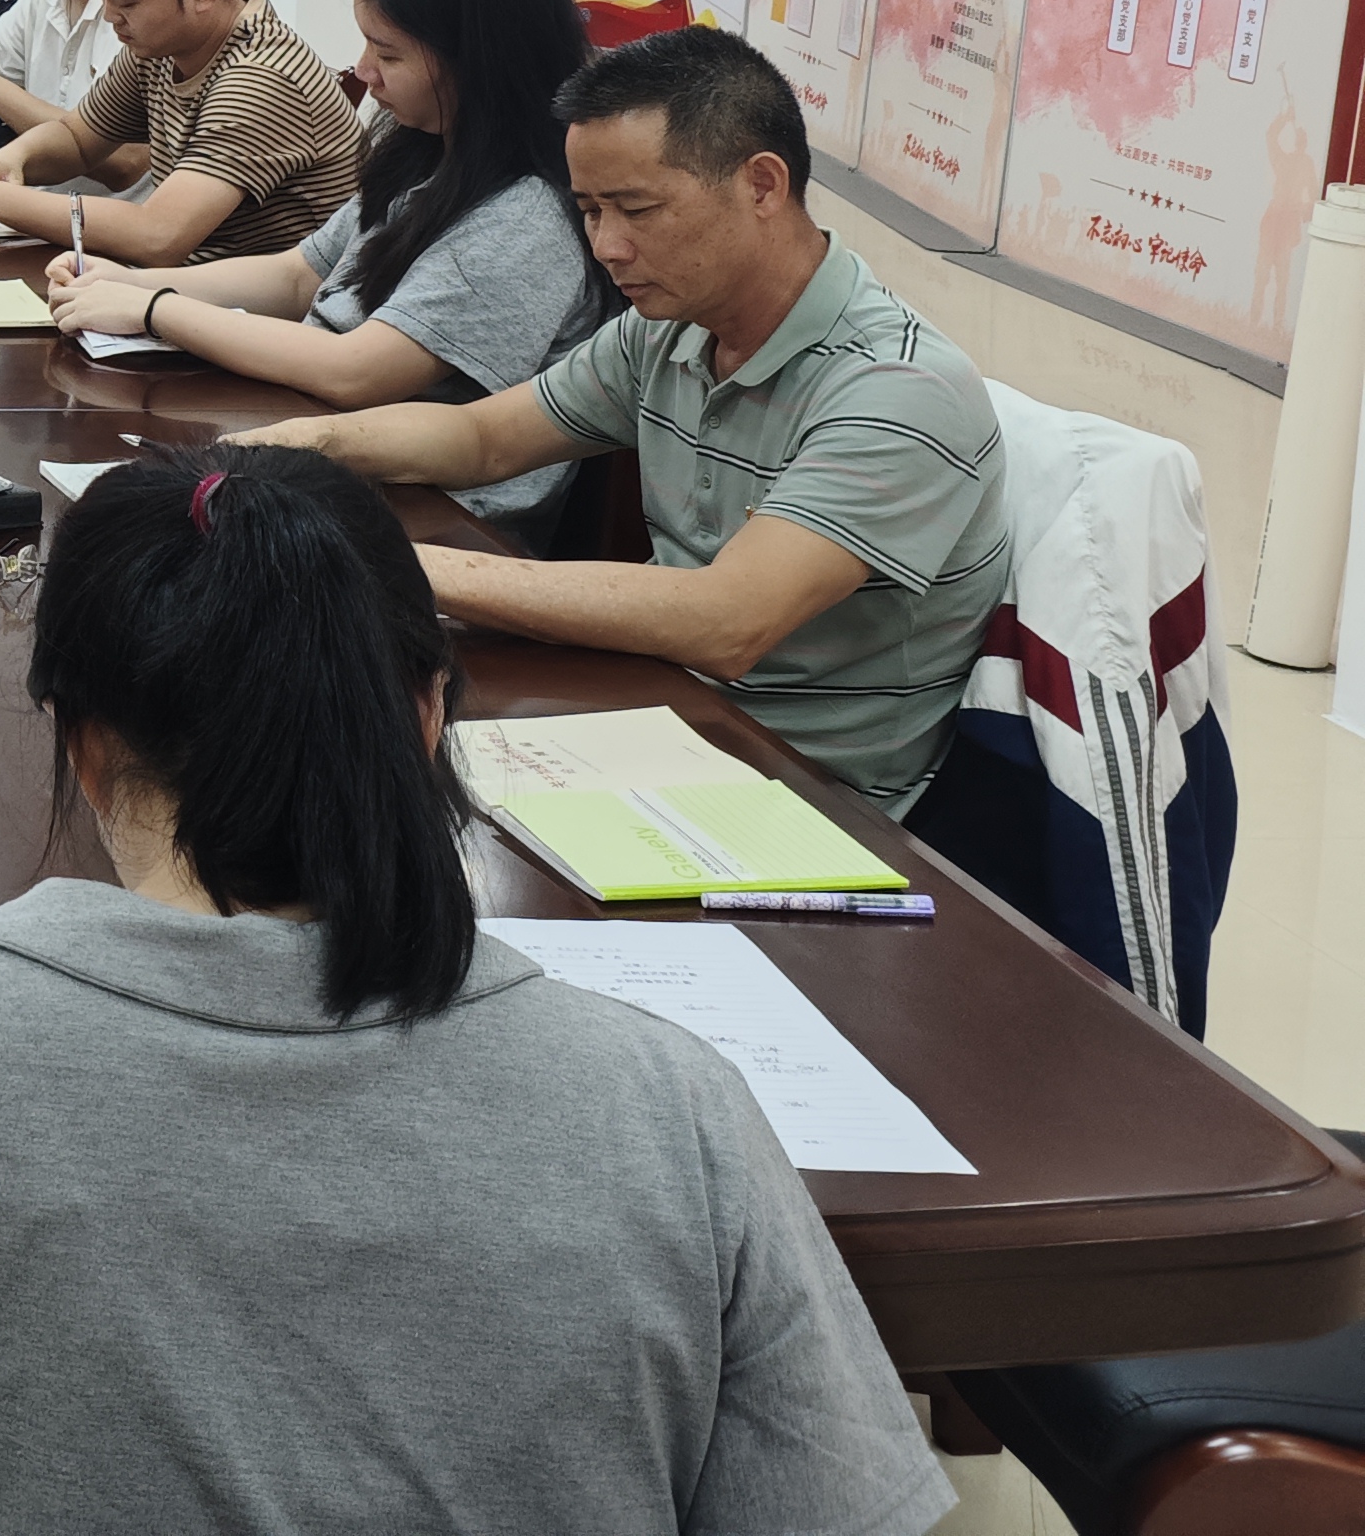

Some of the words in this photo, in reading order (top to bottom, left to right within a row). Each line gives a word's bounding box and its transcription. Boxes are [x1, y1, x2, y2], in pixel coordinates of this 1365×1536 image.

[1086, 214, 1143, 253] 不忘初心
[1148, 232, 1208, 282] 牢记使命
